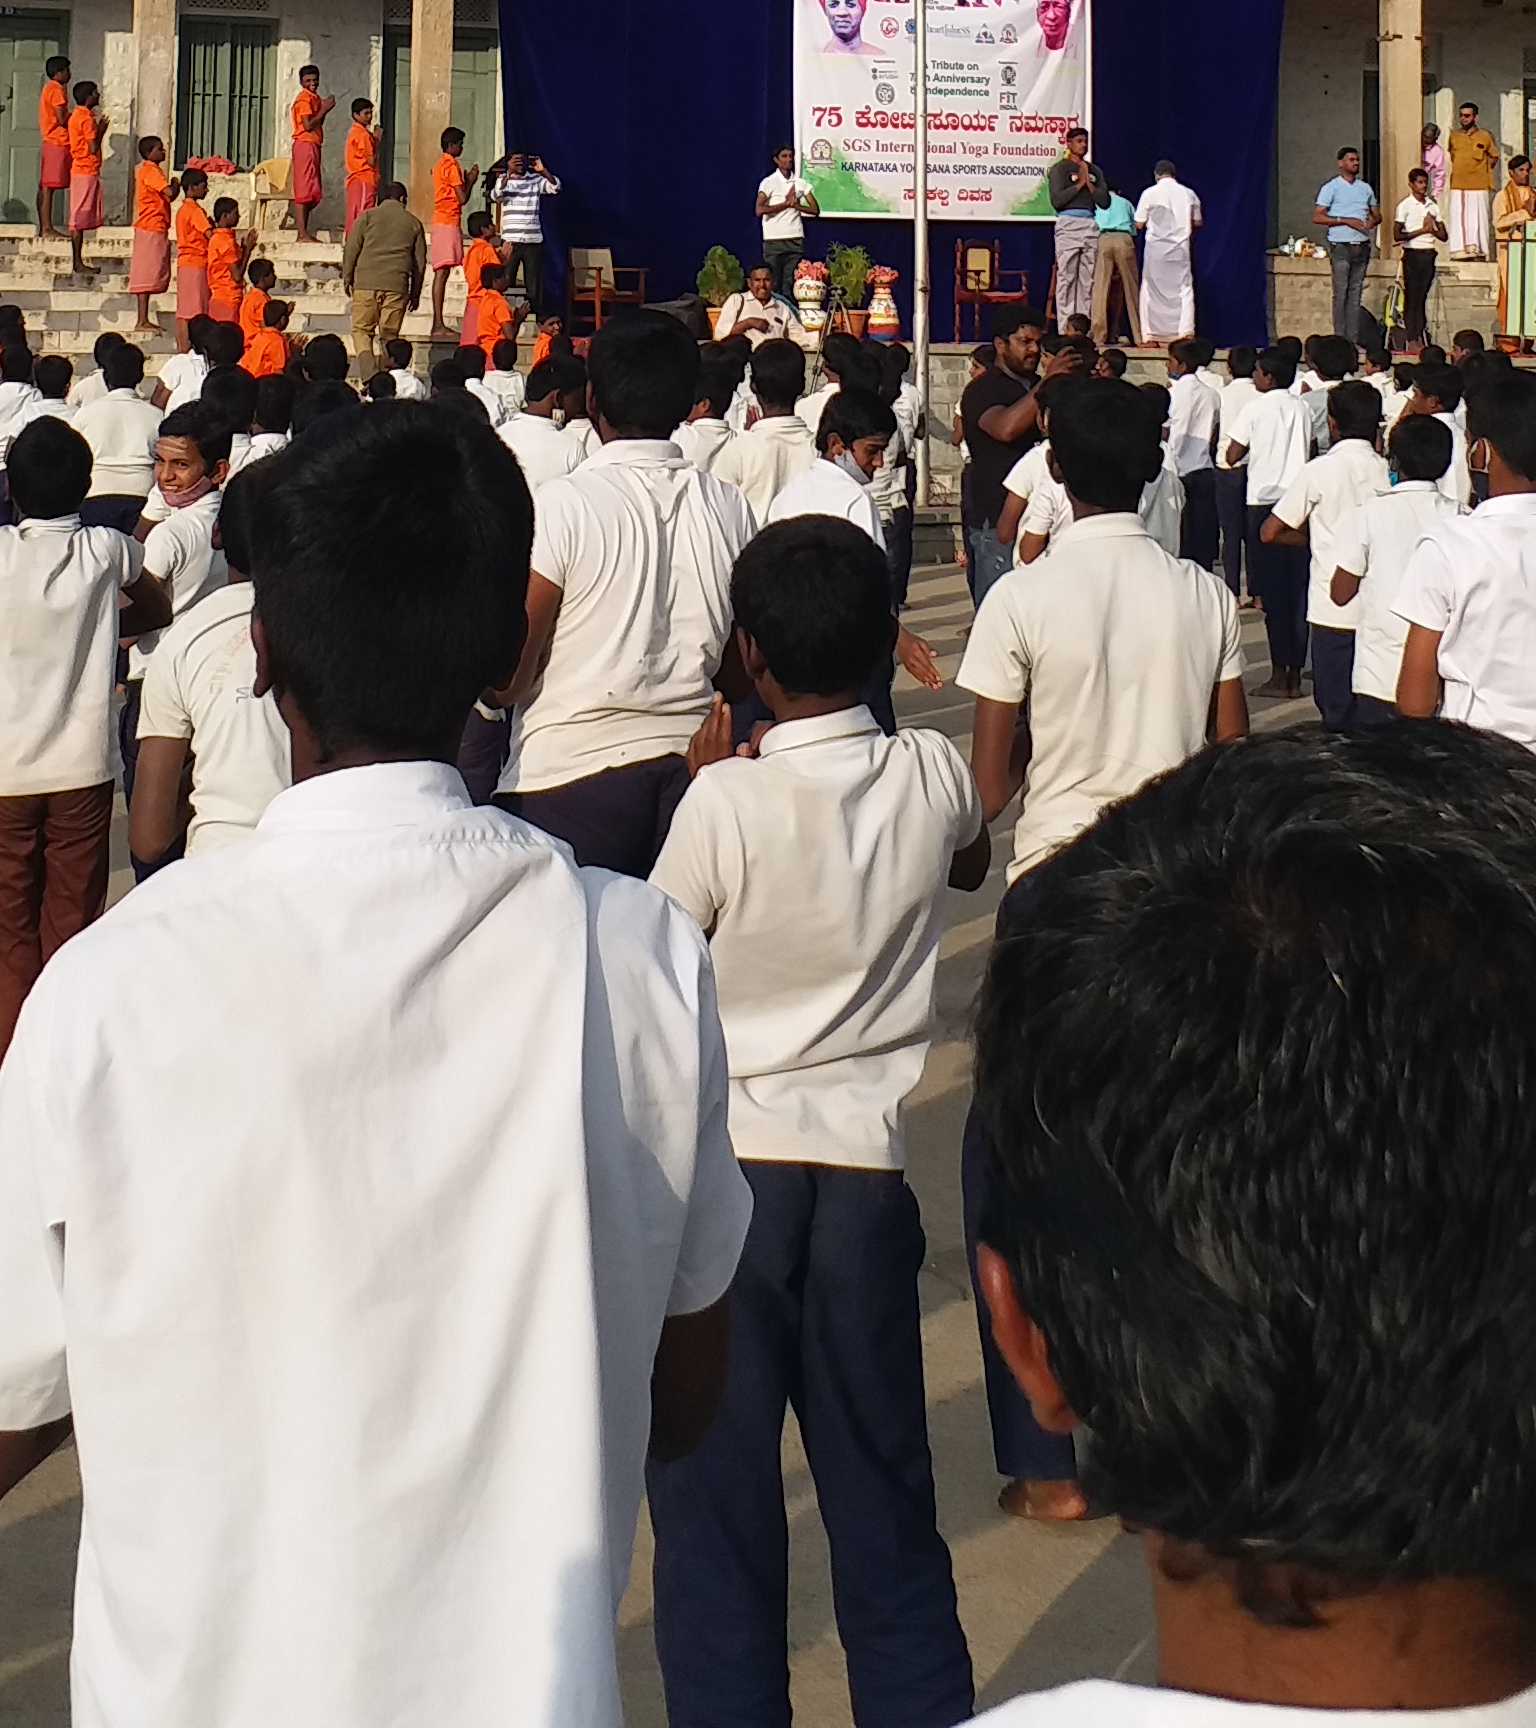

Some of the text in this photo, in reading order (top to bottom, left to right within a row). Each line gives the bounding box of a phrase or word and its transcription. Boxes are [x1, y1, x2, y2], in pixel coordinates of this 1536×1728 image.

[930, 60, 965, 70] Tribute
[967, 63, 980, 71] on
[932, 73, 991, 86] Anniversary
[925, 85, 990, 98] ndependence
[811, 105, 843, 128] 75
[842, 138, 872, 153] SGS
[960, 141, 989, 159] Yoga
[992, 142, 1057, 157] Foundation
[841, 161, 899, 173] KARNATAKA
[952, 164, 988, 175] SPORTS
[989, 165, 1044, 177] ASSOCIATION
[957, 186, 994, 202] ದಿವಸ
